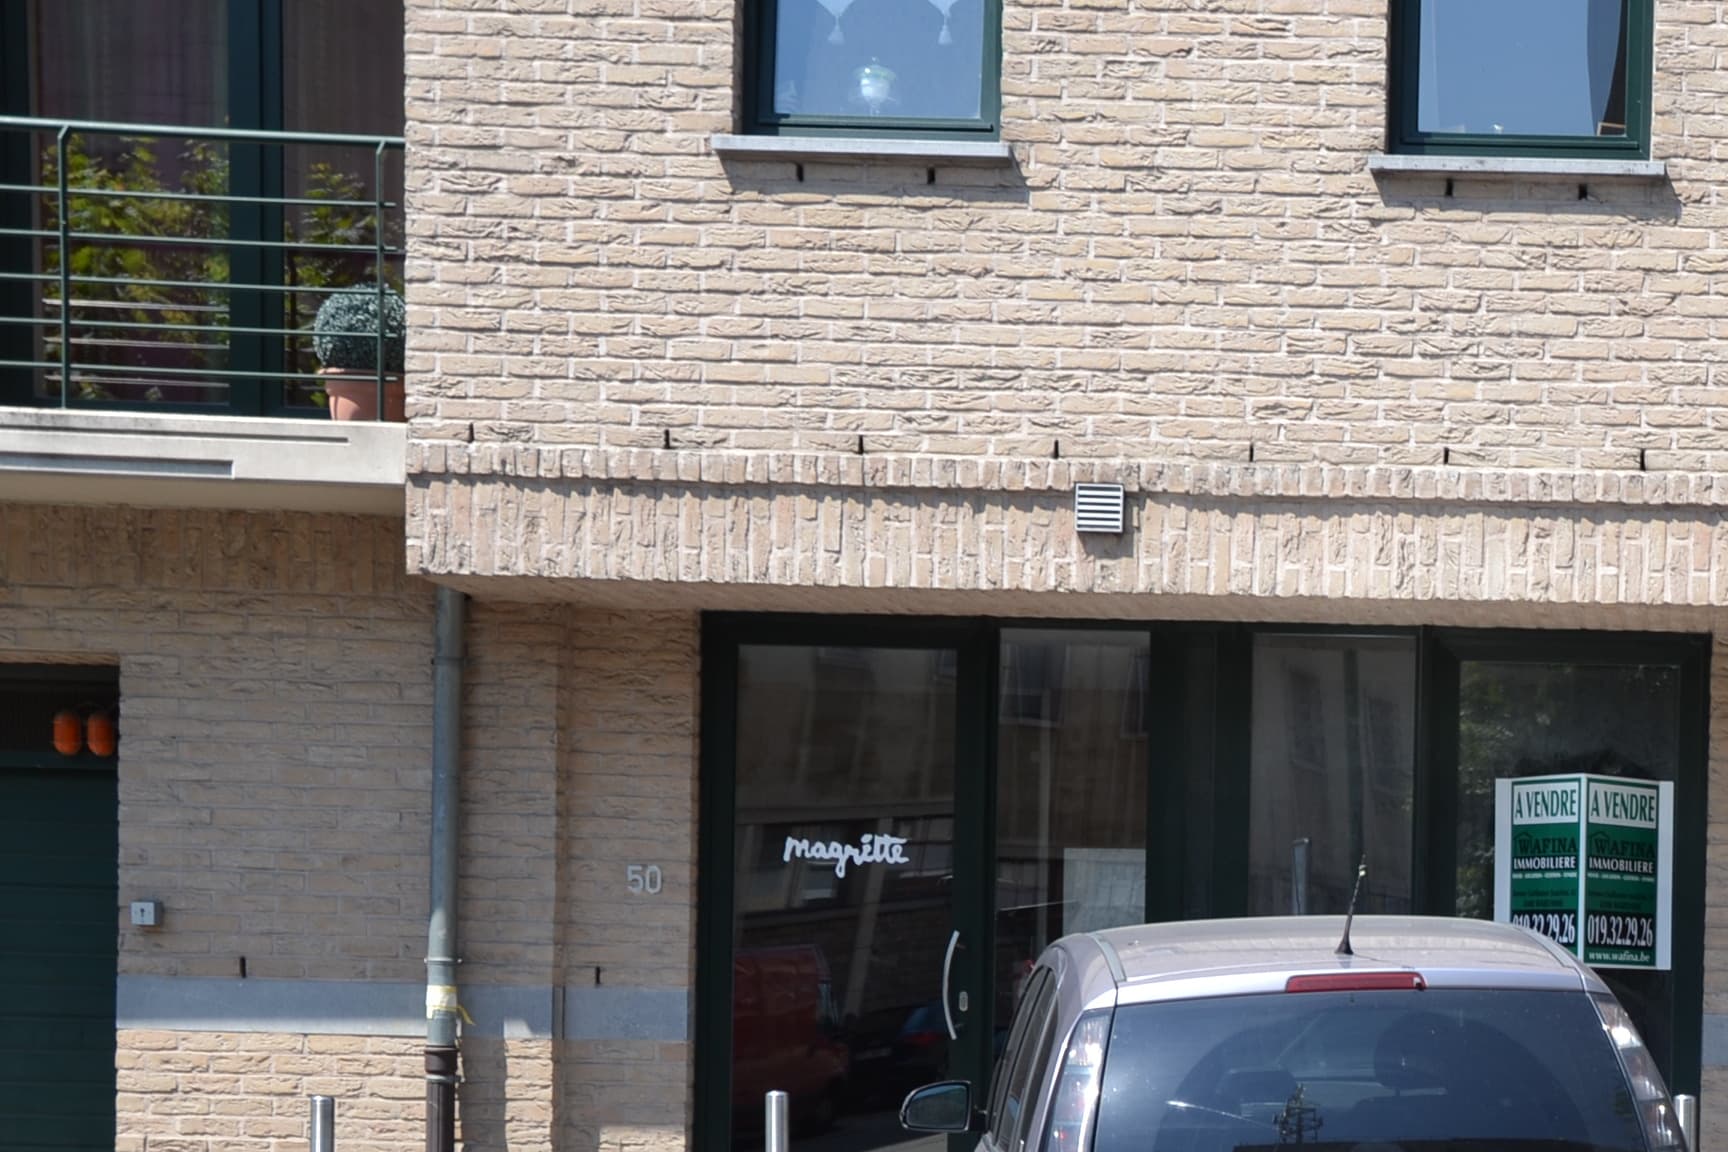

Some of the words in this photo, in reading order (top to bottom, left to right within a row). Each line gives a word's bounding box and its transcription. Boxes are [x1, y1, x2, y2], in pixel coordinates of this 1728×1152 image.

[1514, 791, 1523, 818] A
[1526, 789, 1577, 818] VENDRE
[1590, 790, 1600, 817] A
[1604, 790, 1655, 823] VENDRE
[783, 833, 909, 878] magritte
[1517, 836, 1577, 856] WAFINA
[1592, 836, 1656, 859] WAFINA
[1513, 856, 1577, 870] IMMOBILIERE
[1588, 857, 1654, 874] IMMOBILIERE
[626, 865, 662, 894] 50
[1587, 914, 1654, 948] 019.32.29.26
[1588, 950, 1651, 963] www.wafina.be
